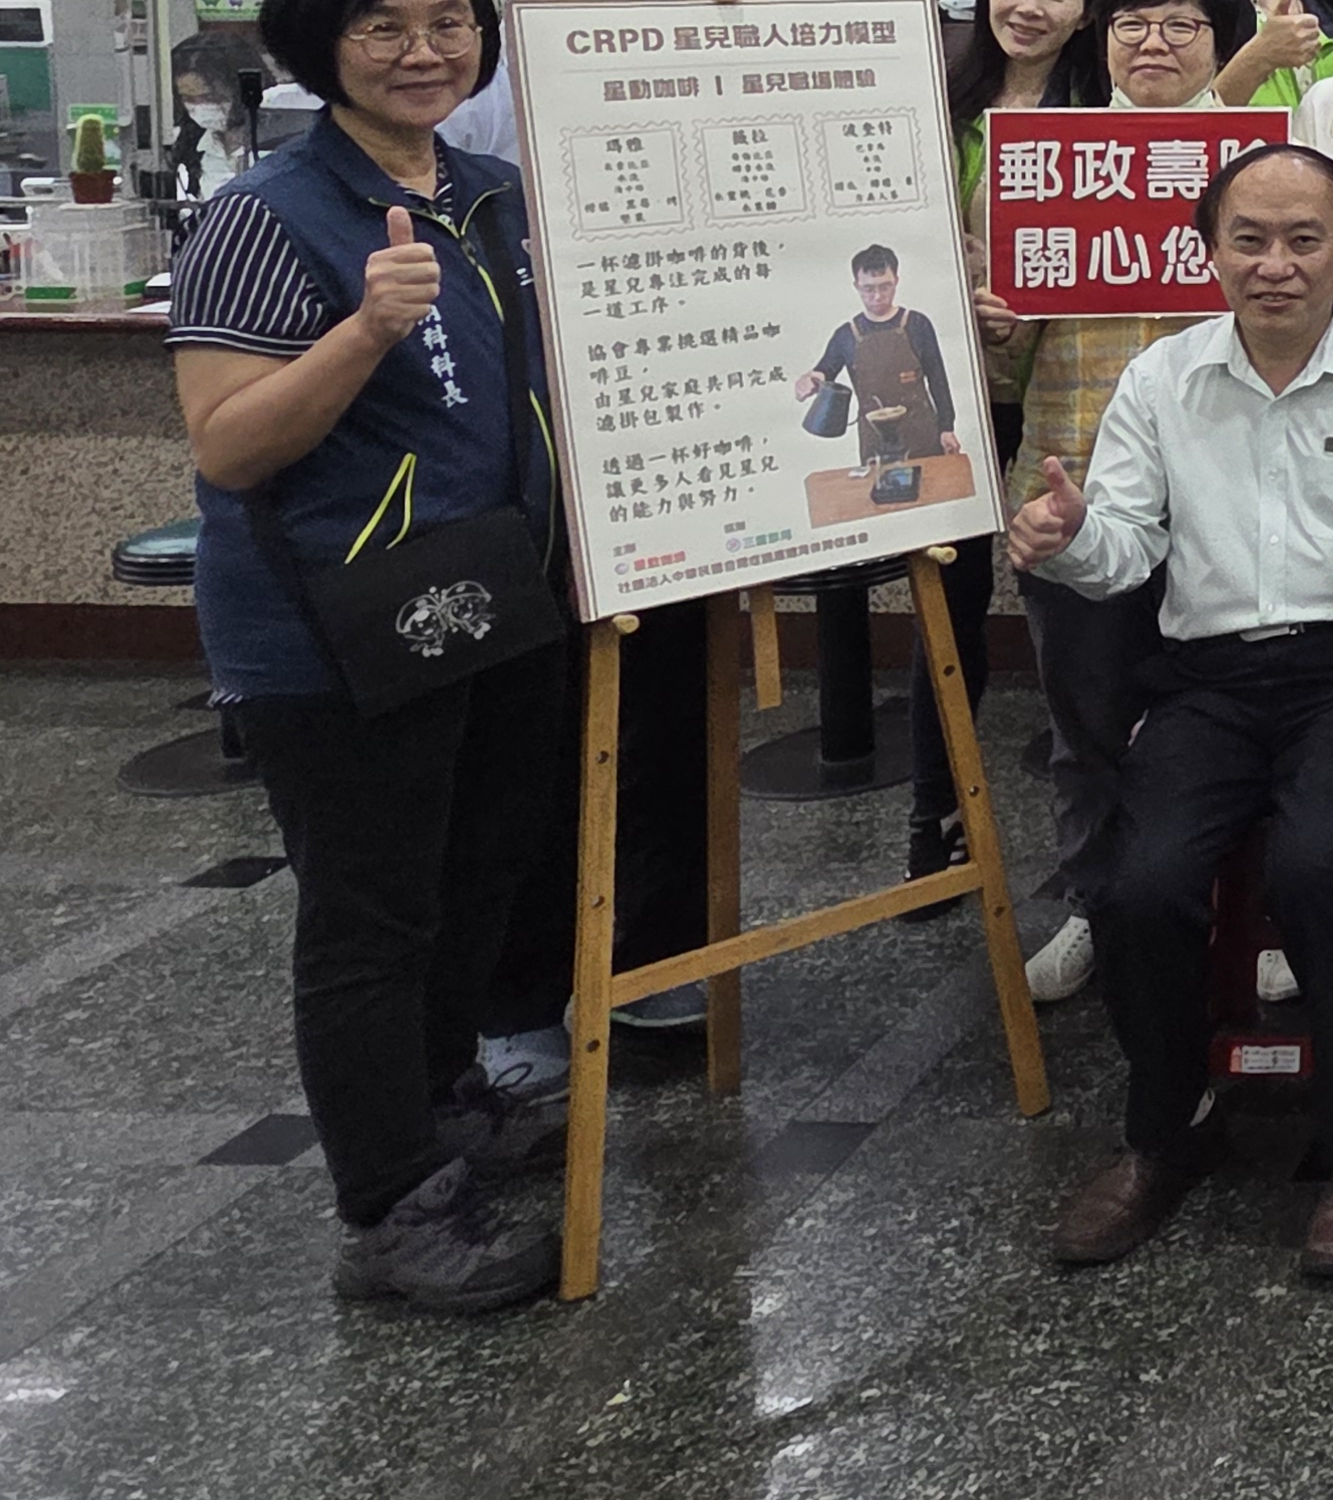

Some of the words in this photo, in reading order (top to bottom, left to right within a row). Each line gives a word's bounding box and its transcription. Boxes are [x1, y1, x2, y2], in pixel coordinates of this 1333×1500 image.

[566, 28, 664, 54] CRPD
[673, 20, 897, 50] 星兒職人培力模型
[998, 139, 1266, 202] 郵政壽
[1014, 226, 1221, 288] 關心您
